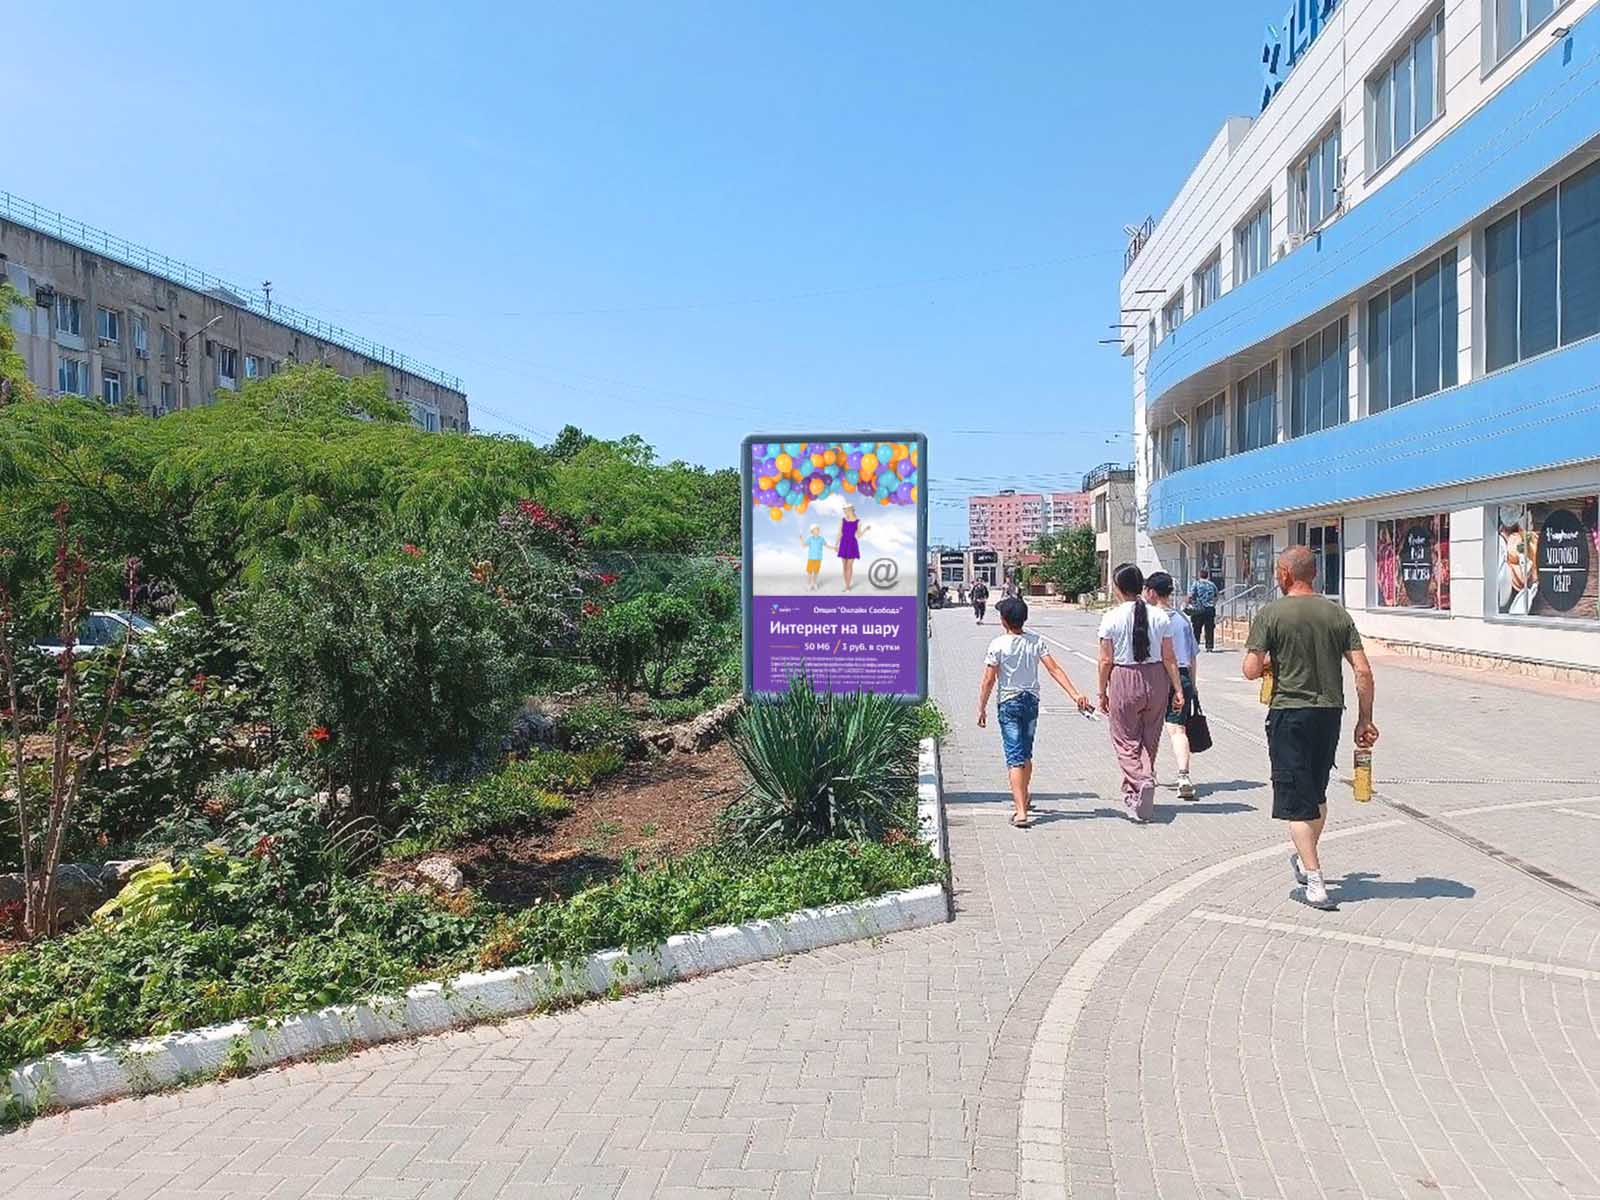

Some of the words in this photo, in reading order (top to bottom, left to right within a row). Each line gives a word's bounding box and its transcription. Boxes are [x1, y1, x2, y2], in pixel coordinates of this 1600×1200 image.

[1553, 575, 1572, 593] СЫР
[813, 606, 837, 615] Опция
[769, 620, 839, 637] Интернет
[841, 624, 858, 635] на
[862, 624, 900, 637] шару
[804, 642, 816, 651] 50
[817, 642, 831, 651] Мб
[849, 642, 867, 653] руб.
[876, 644, 901, 653] сутки
